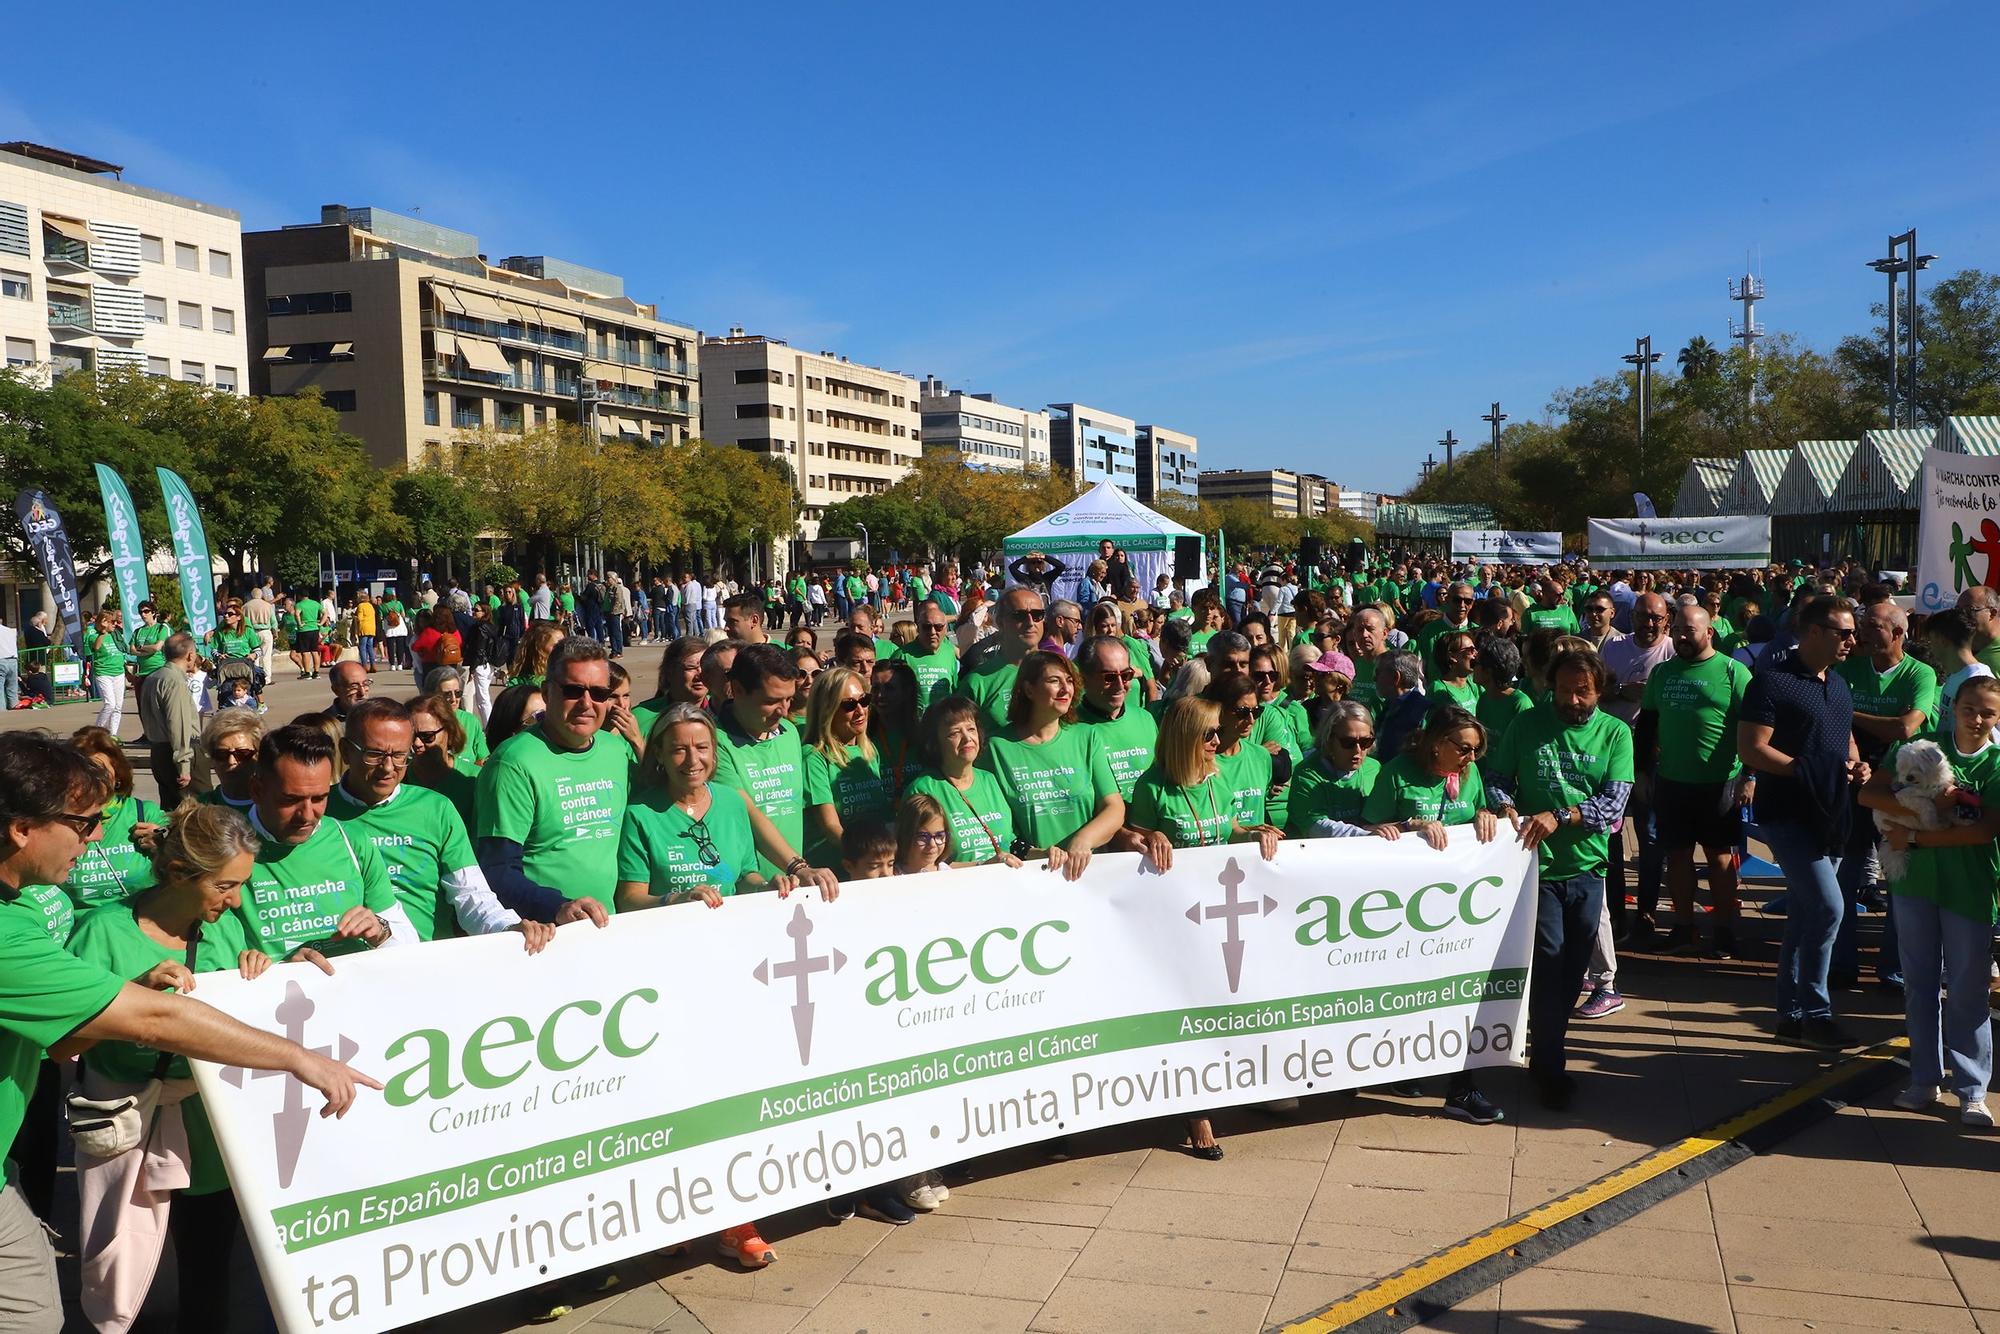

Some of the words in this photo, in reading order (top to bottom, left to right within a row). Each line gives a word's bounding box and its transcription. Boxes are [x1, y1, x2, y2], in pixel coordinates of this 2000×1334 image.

[1006, 540, 1049, 550] ASOCIACIÓN
[1050, 540, 1089, 548] ESPAÑOLA
[1090, 540, 1121, 548] CORA
[1132, 538, 1163, 546] CÁNCER
[1661, 530, 1724, 544] aecc
[1113, 746, 1148, 760] marcha
[747, 767, 760, 778] En
[762, 762, 794, 776] marcha
[1013, 771, 1029, 781] En
[1032, 765, 1075, 779] marcha
[557, 783, 573, 797] En
[575, 778, 614, 794] marcha
[752, 777, 781, 790] contra
[840, 781, 854, 793] En
[1016, 780, 1054, 792] contra
[561, 795, 597, 811] contra
[755, 791, 764, 802] el
[766, 788, 793, 801] cáncer
[1019, 792, 1029, 803] el
[1032, 788, 1071, 801] cáncer
[1431, 799, 1467, 812] mrcha
[563, 811, 574, 825] el
[576, 807, 612, 822] cáncer
[952, 816, 967, 828] En
[968, 811, 1002, 825] mrcha
[1176, 818, 1191, 829] En
[961, 838, 971, 849] el
[973, 833, 1003, 847] cáner
[1175, 831, 1212, 841] conta
[668, 850, 684, 861] En
[670, 872, 708, 884] contra
[253, 888, 279, 905] En
[284, 879, 347, 901] marcha
[258, 901, 315, 921] contra
[1294, 875, 1504, 947] aecc
[260, 921, 276, 937] el
[281, 912, 340, 934] cáncer
[1326, 947, 1387, 968] Contra
[1397, 941, 1410, 958] el
[1420, 935, 1475, 957] Cáncer
[864, 918, 1072, 1007] aecc
[896, 1000, 955, 1028] Contra
[964, 993, 978, 1015] el
[985, 986, 1046, 1012] Cáncer
[1179, 1006, 1287, 1037] Asociación
[1291, 994, 1376, 1026] Española
[1379, 986, 1438, 1012] Contra
[1441, 980, 1456, 1001] el
[1459, 970, 1526, 998] Cáncer
[383, 987, 660, 1107] aecc
[759, 1078, 864, 1122] Asociación
[867, 1057, 949, 1098] Española
[953, 1045, 1015, 1077] Contra
[1018, 1038, 1035, 1064] el
[1039, 1029, 1099, 1060] Cáncer
[428, 1099, 512, 1134] Contra
[523, 1085, 541, 1112] el
[551, 1072, 627, 1105] Cáncer
[381, 1178, 642, 1307] Provincial
[655, 1166, 715, 1226] de
[725, 1119, 909, 1203] Córdoba
[956, 1088, 1060, 1144] Junta
[1071, 1043, 1269, 1117] Provincial
[1282, 1038, 1334, 1083] de
[1346, 1015, 1514, 1073] Córdoba
[359, 1174, 480, 1225] Española
[487, 1154, 566, 1192] Contra
[573, 1139, 594, 1170] el
[598, 1124, 674, 1163] Cáncer
